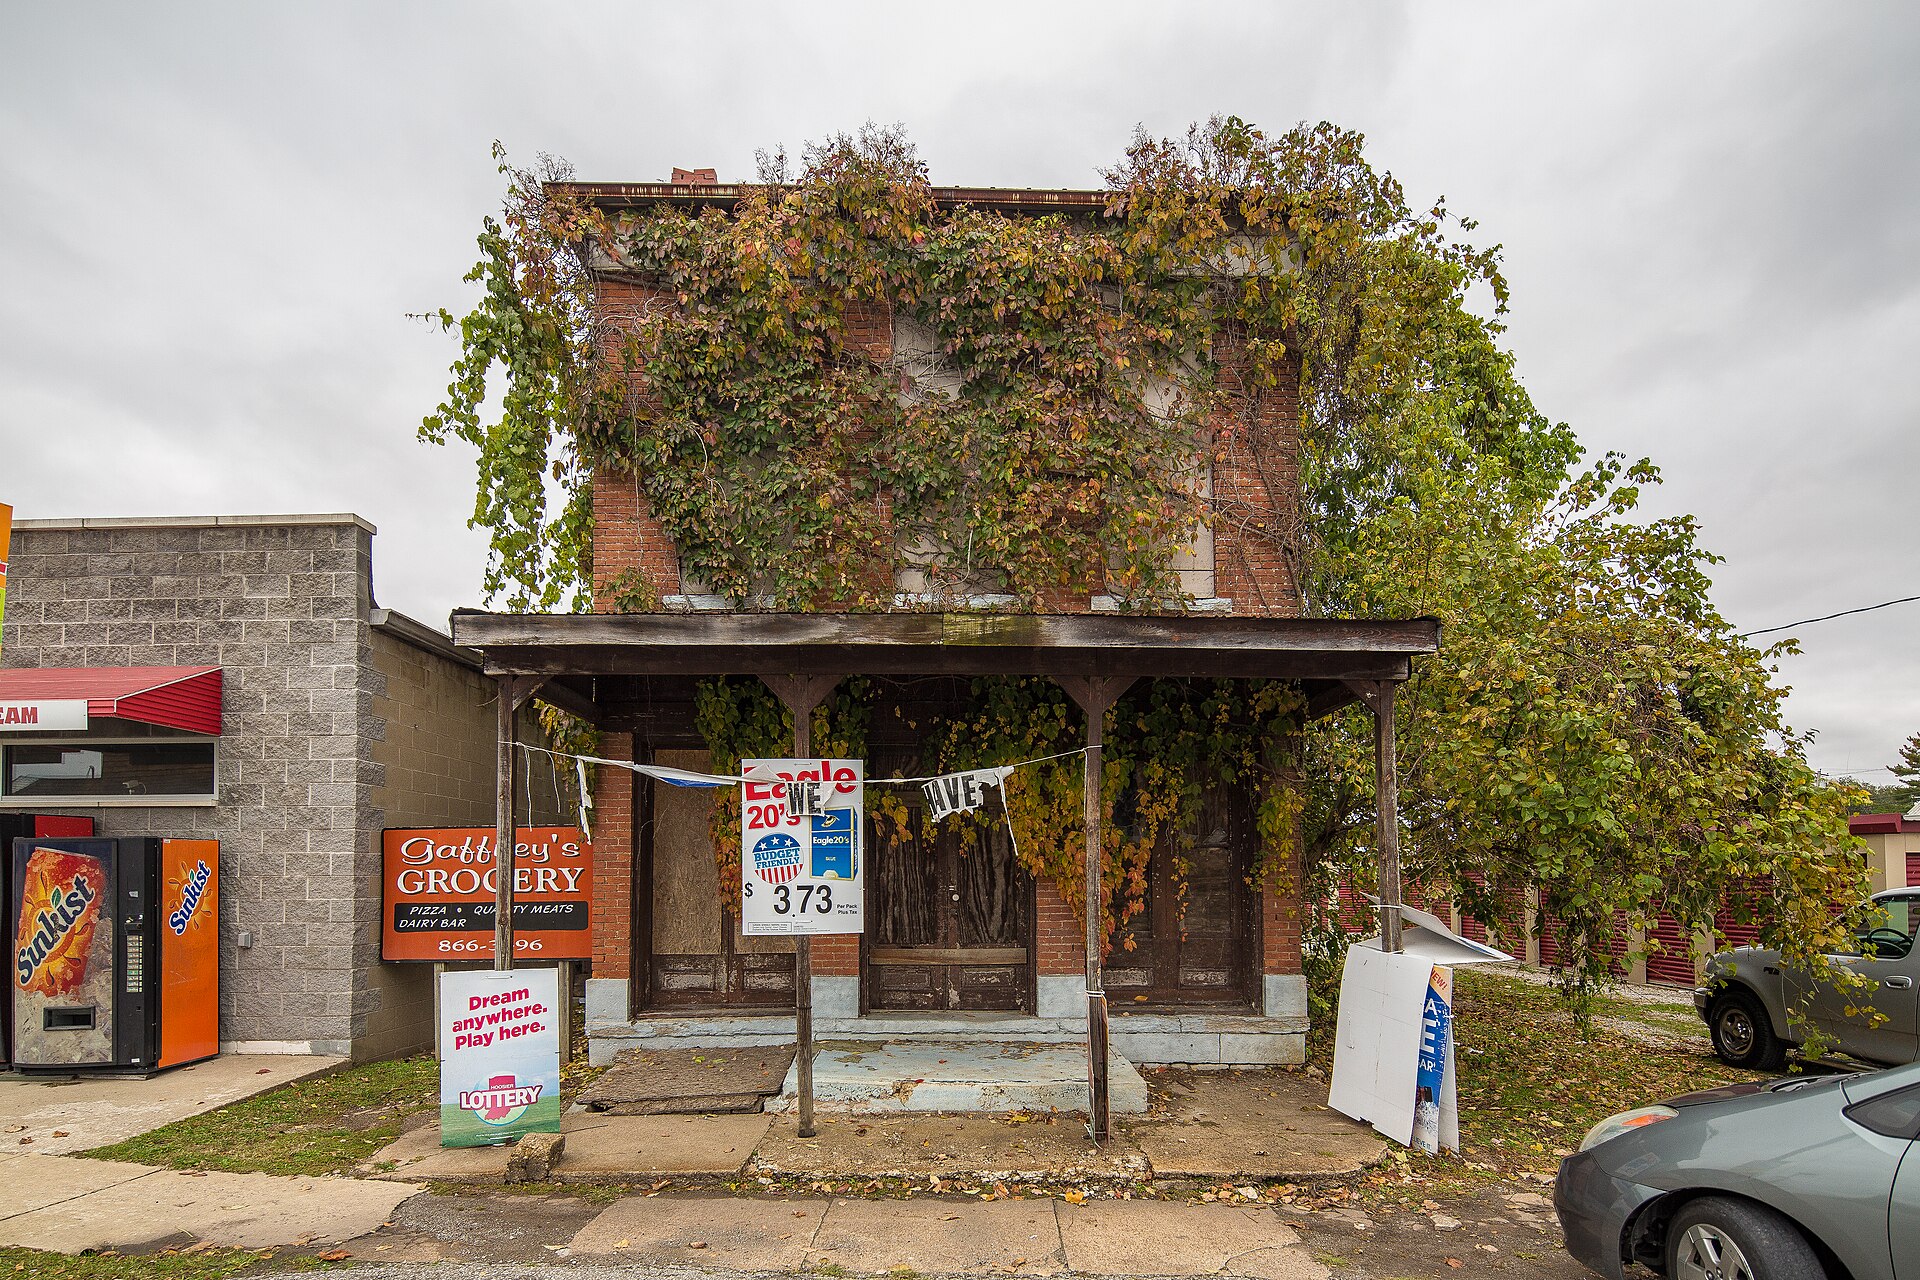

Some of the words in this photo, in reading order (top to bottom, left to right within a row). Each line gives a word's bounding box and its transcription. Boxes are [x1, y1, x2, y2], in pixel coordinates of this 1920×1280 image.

[787, 782, 822, 815] WE
[747, 803, 801, 829] 20's
[400, 833, 581, 865] Gaffey's
[812, 835, 850, 846] Eagle20's
[753, 847, 801, 862] BUDGET
[755, 856, 800, 869] FRIENDLY
[168, 859, 211, 936] Sunkist
[409, 906, 448, 915] PIZZA
[530, 904, 574, 914] MEATS
[744, 881, 754, 899] $
[773, 884, 833, 918] 3.73
[16, 874, 95, 985] Sunkist
[398, 918, 438, 928] DAIRY
[440, 918, 467, 928] BAR
[438, 939, 543, 952] 866-396
[468, 987, 530, 1011] Dream
[452, 1003, 548, 1032] anywhere.
[455, 1031, 494, 1050] Play
[499, 1020, 546, 1040] here.
[460, 1085, 542, 1110] LOTTERY
